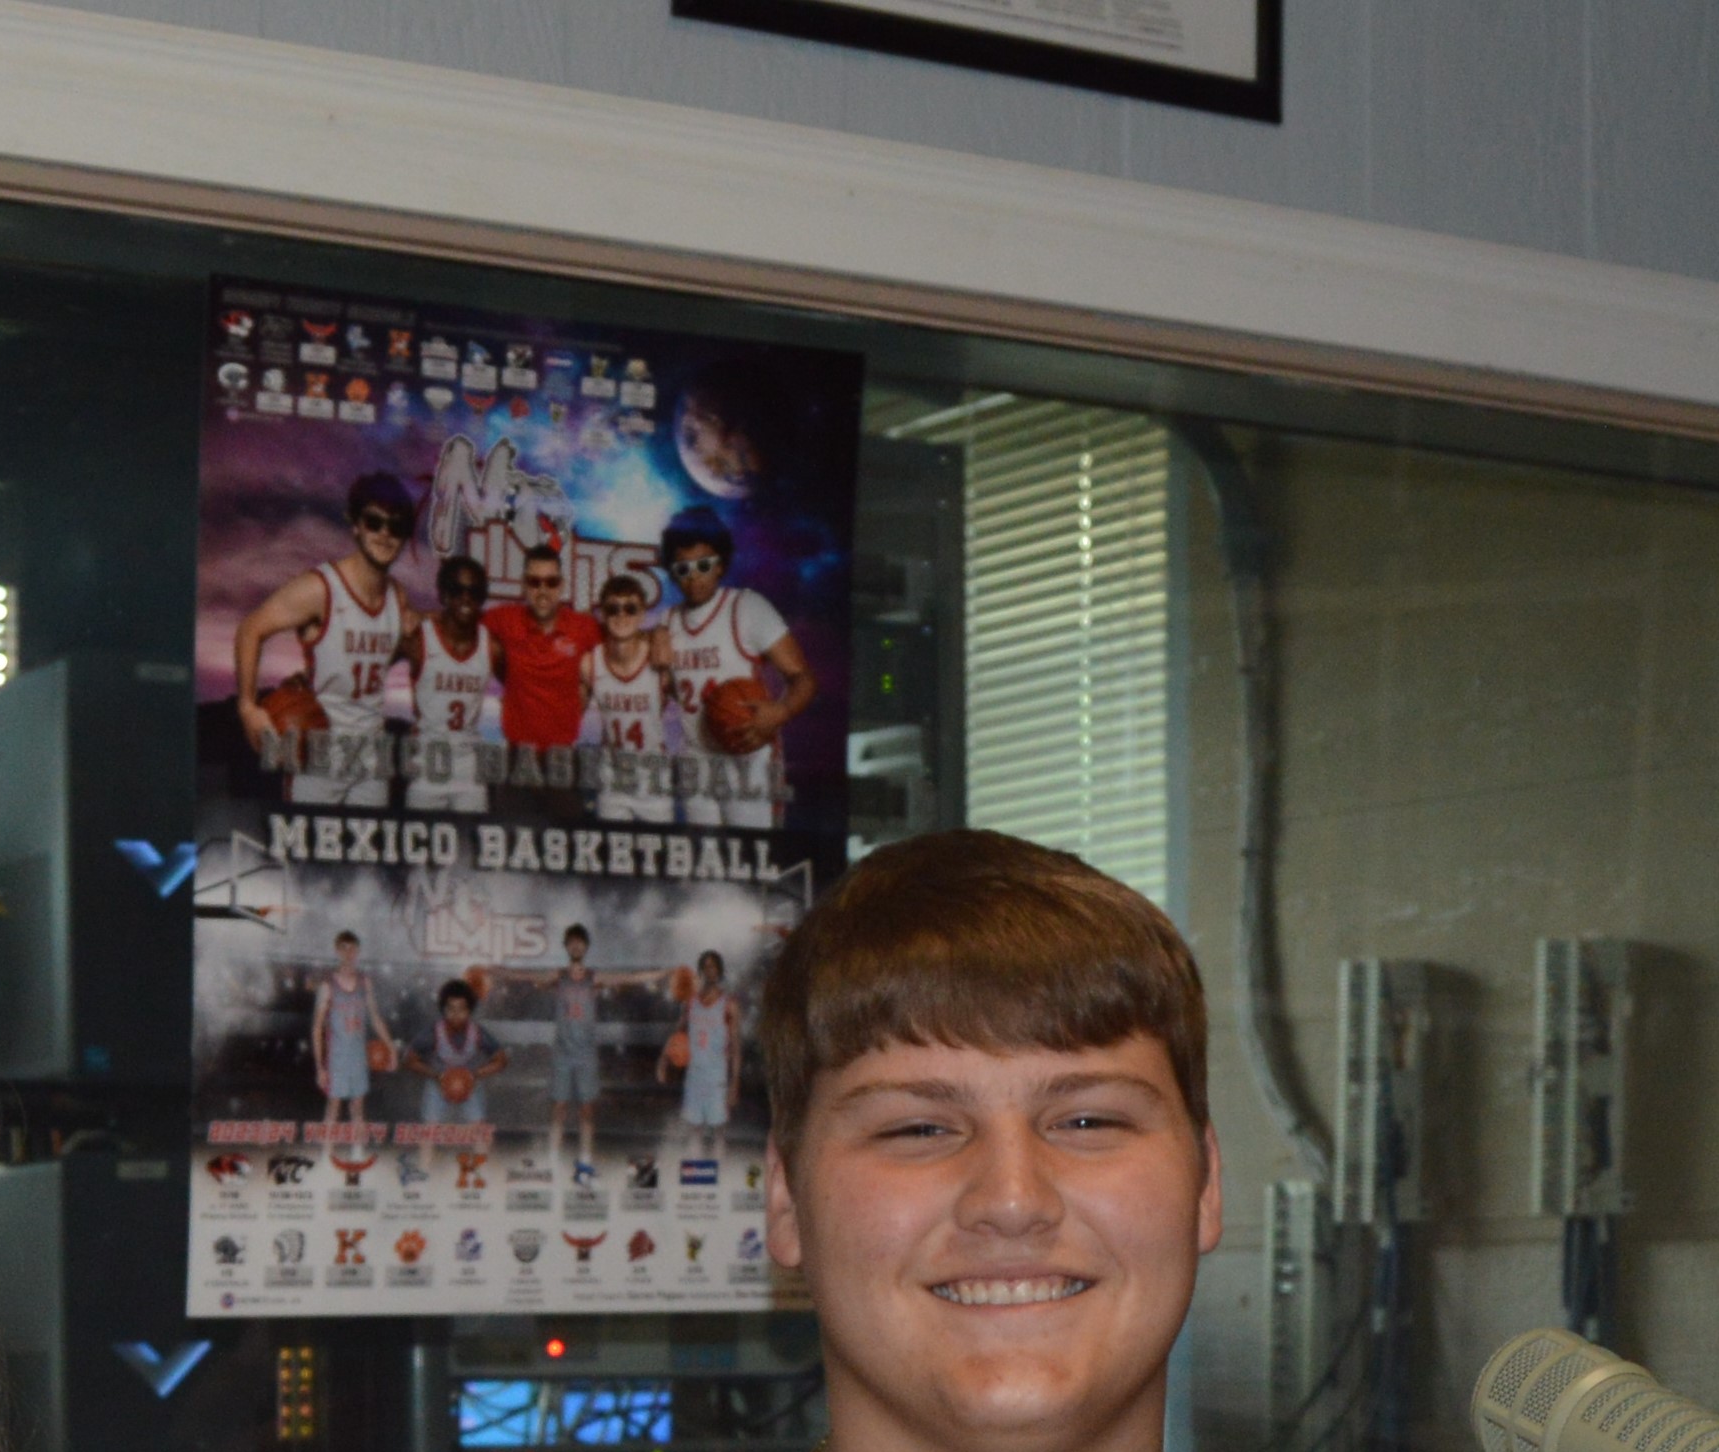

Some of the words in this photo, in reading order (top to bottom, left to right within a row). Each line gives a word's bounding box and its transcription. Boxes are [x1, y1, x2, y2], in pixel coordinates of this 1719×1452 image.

[447, 700, 466, 731] 3
[267, 811, 459, 867] MEXICO
[476, 824, 781, 883] BASKETBALL
